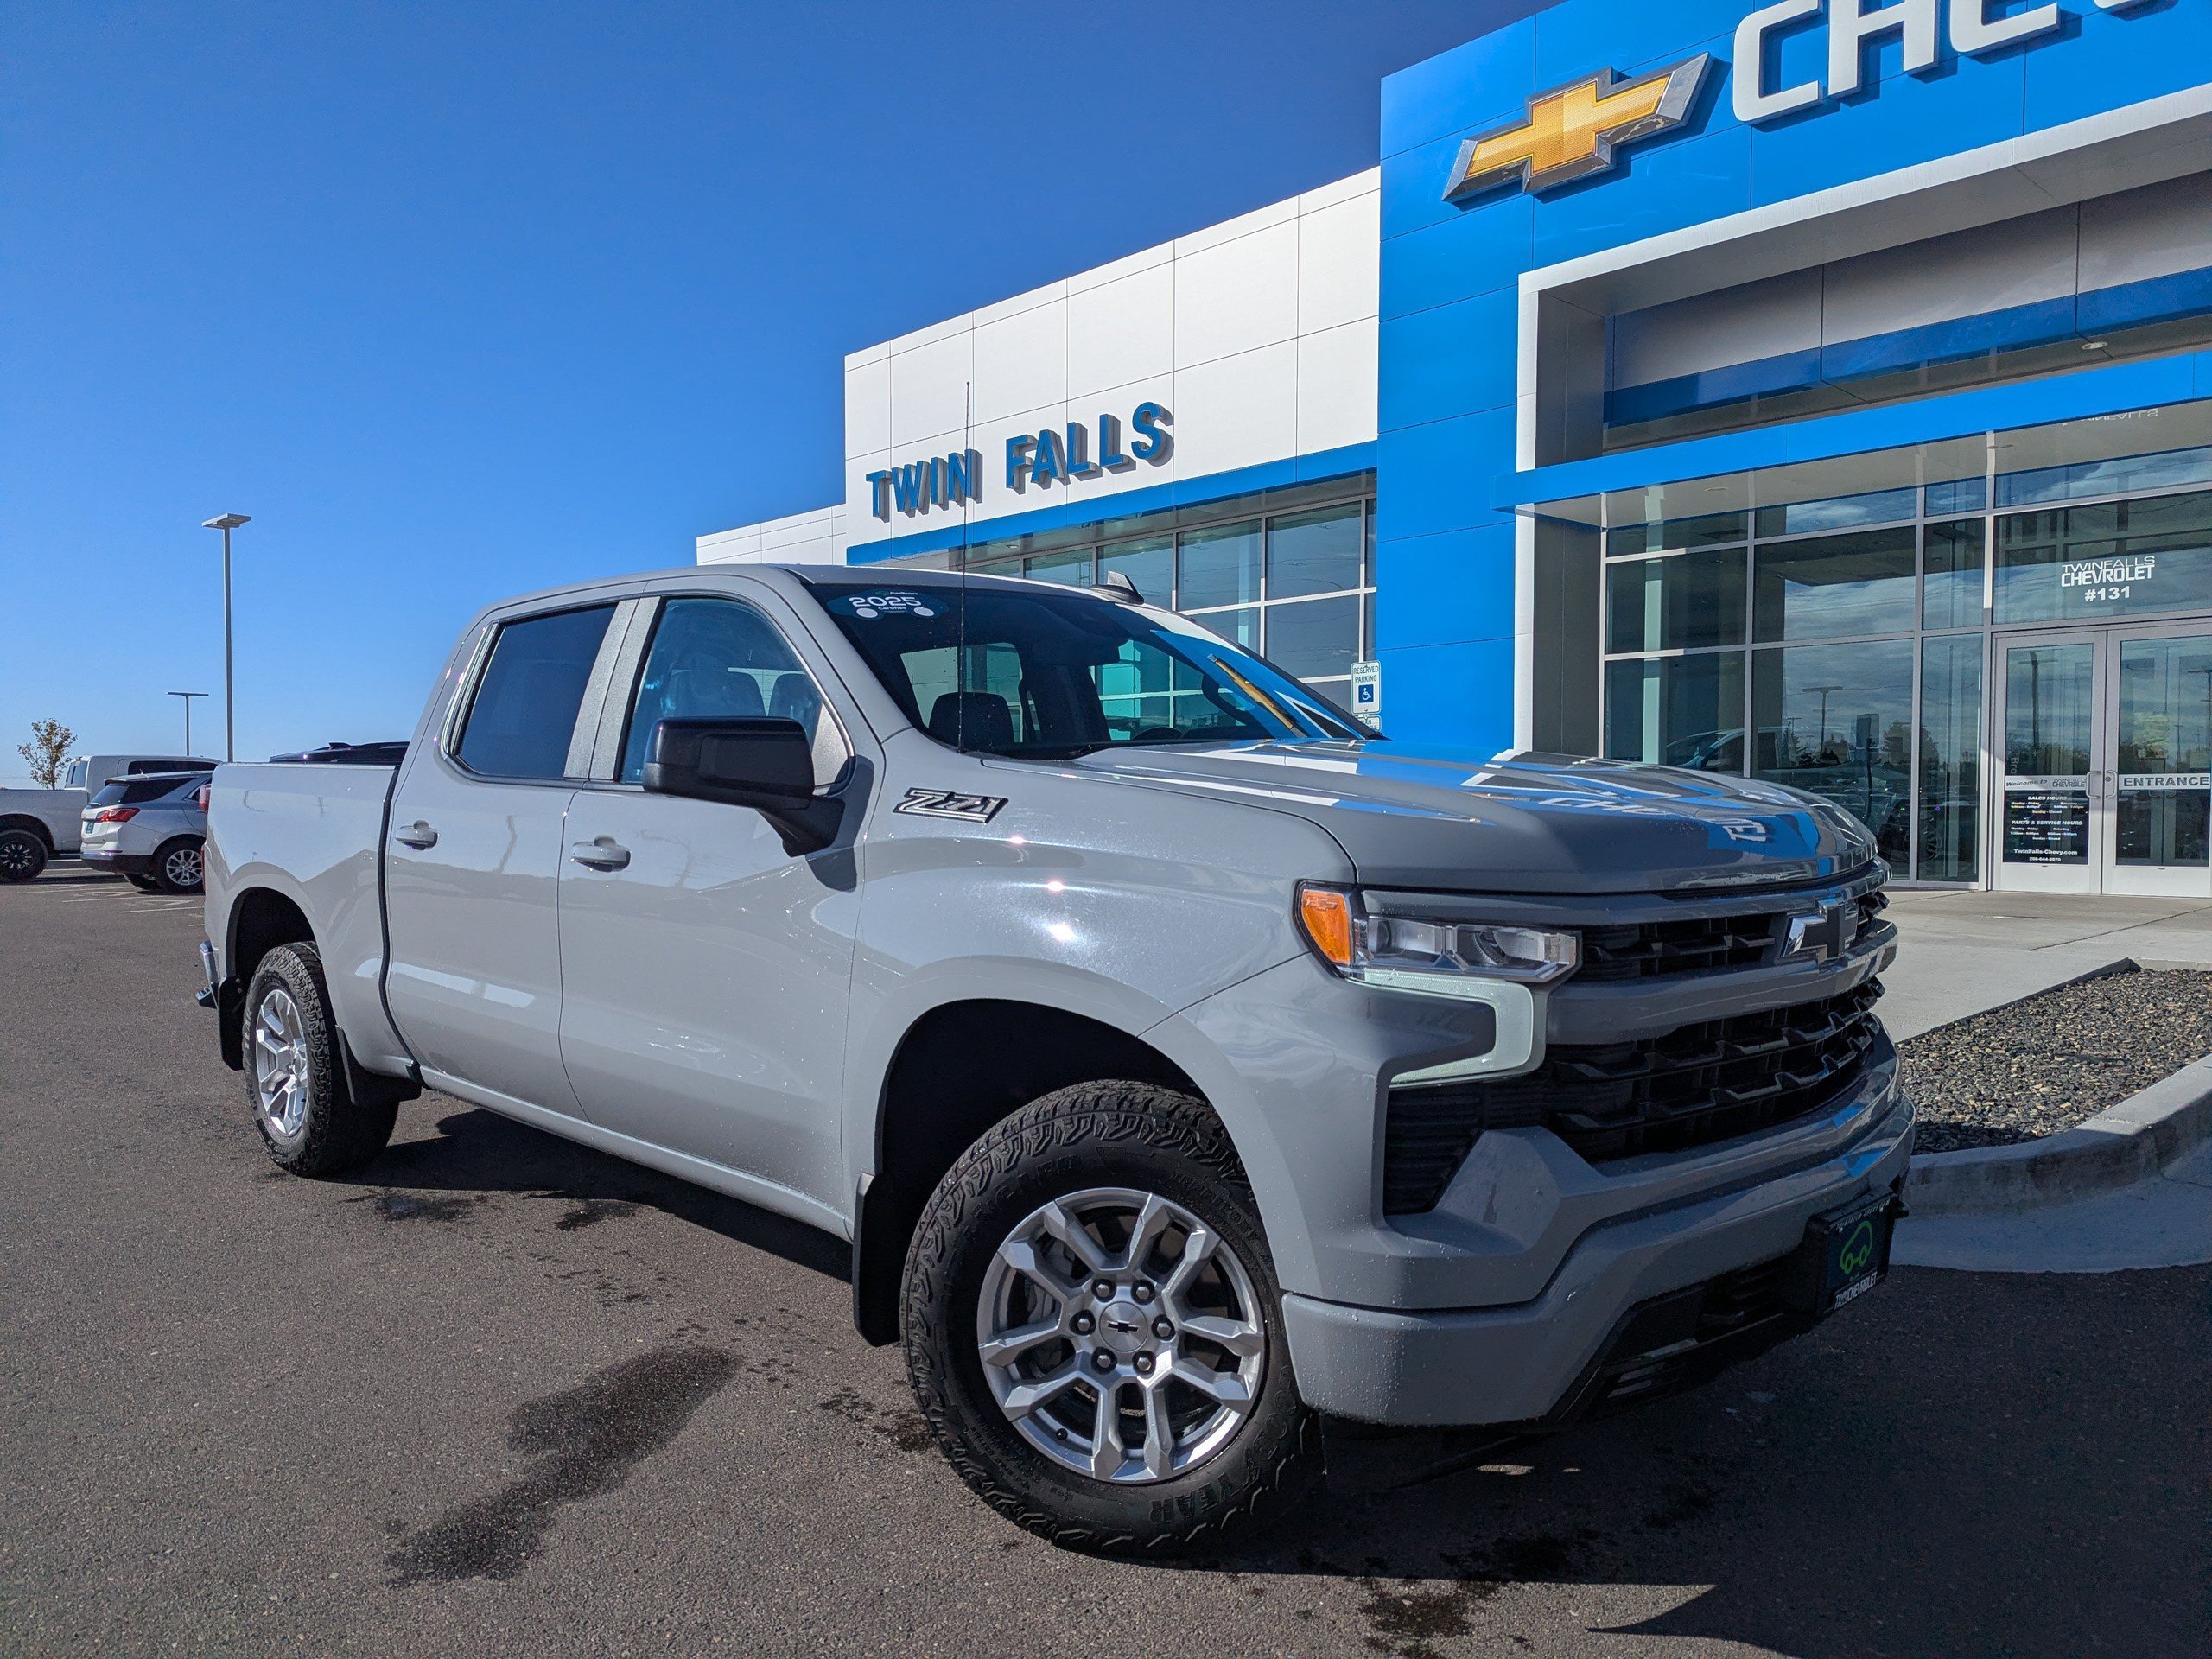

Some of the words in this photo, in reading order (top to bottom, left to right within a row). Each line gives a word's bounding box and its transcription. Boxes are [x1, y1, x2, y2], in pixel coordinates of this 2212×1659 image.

[866, 448, 980, 521] TWIN
[1006, 402, 1173, 494] FALLS
[2062, 556, 2155, 573] TWINFALLS
[2062, 564, 2155, 587] CHEVROLET
[2084, 586, 2130, 601] #131
[849, 596, 922, 607] 2025
[1353, 665, 1379, 675] RESERVED
[1355, 675, 1377, 683] PARKING
[2123, 777, 2209, 787] ENTRANCE
[892, 787, 1009, 824] Z71
